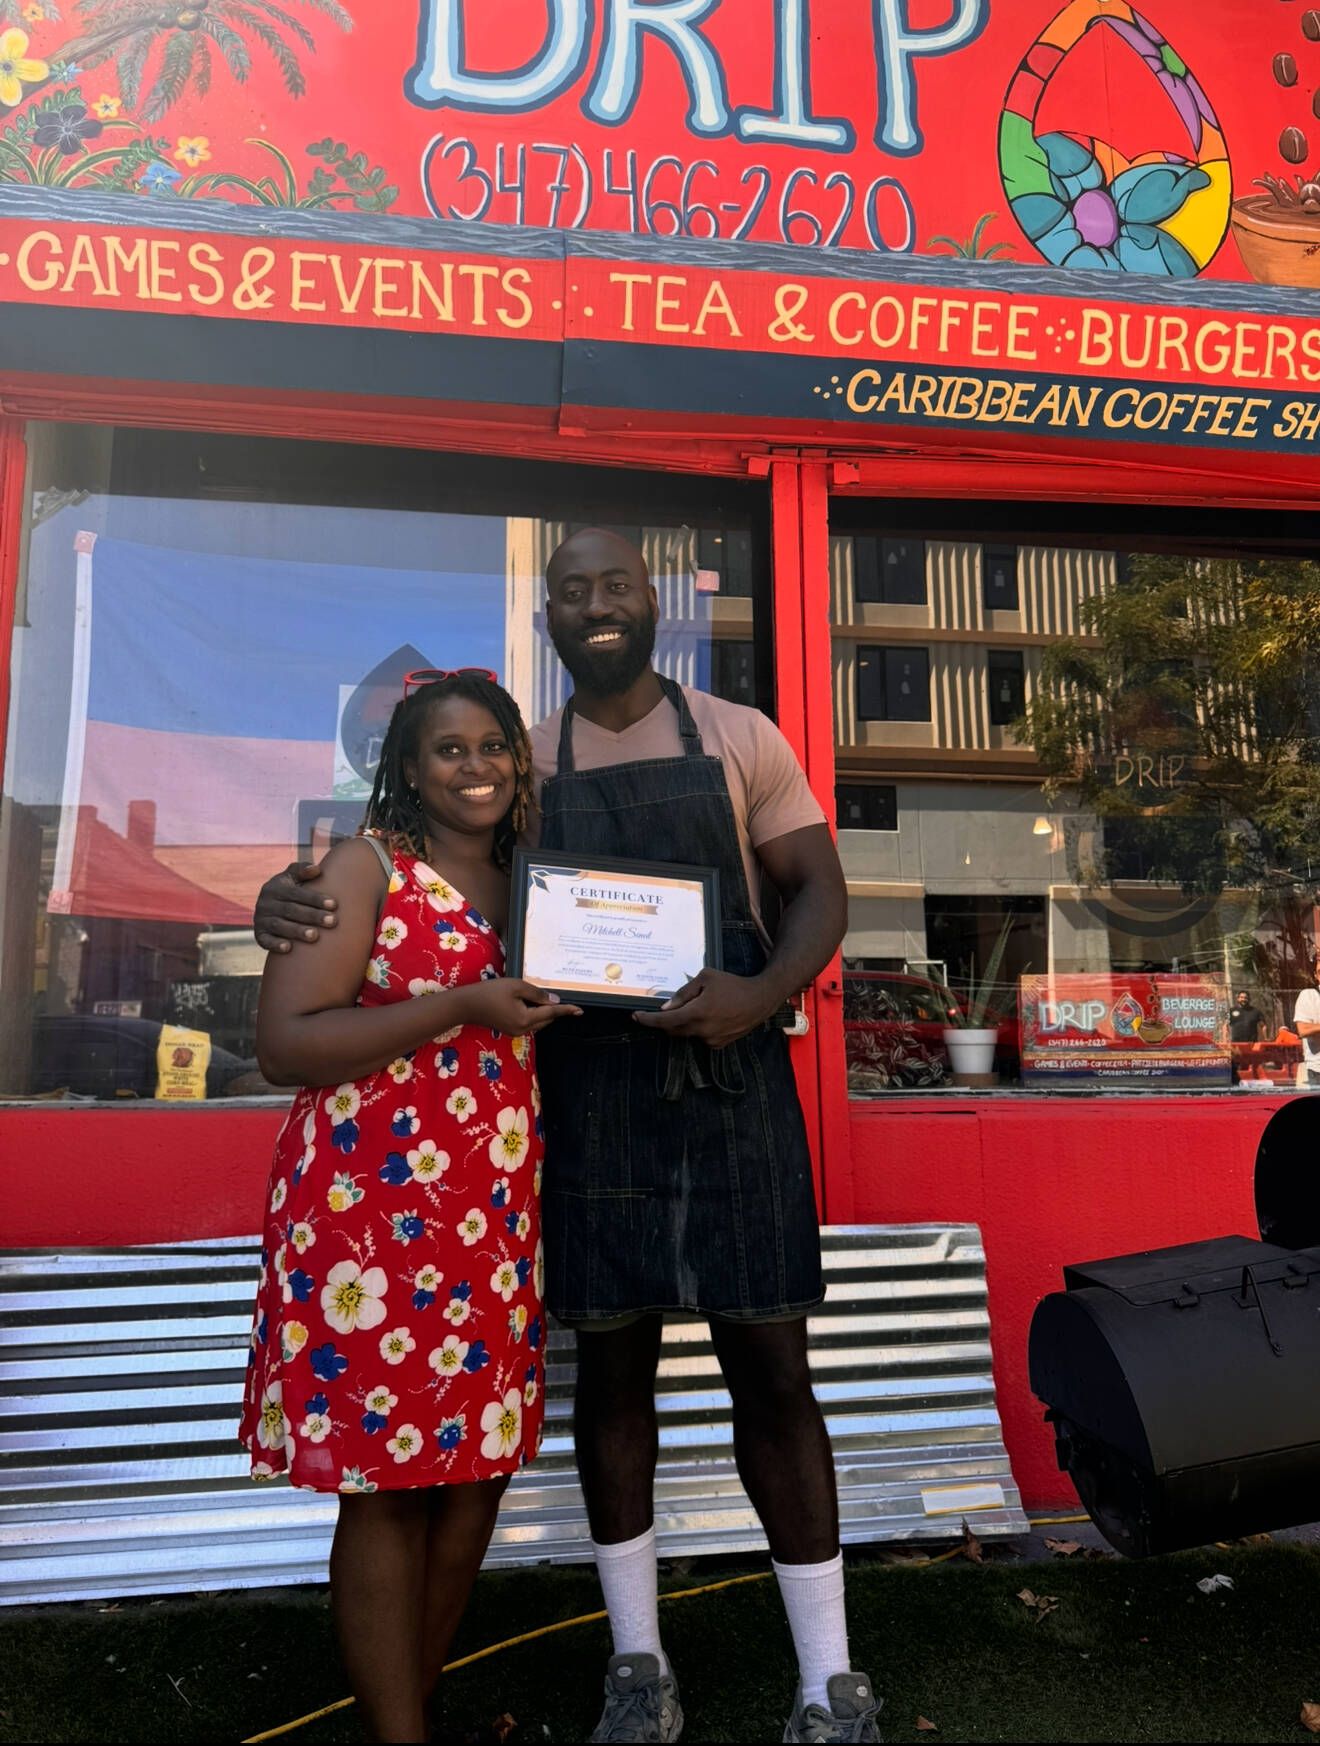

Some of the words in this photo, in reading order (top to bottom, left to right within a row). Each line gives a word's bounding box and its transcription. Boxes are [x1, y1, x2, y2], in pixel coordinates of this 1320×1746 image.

[404, 0, 990, 157] DRIP
[420, 133, 593, 229] (347)
[17, 231, 224, 304] GAMES
[233, 247, 274, 310] &
[290, 251, 532, 329] EVENTS
[610, 273, 741, 337] TEA
[767, 284, 814, 342] &
[828, 292, 1038, 361] COFFEE
[846, 369, 1102, 428] CARIBBEAN
[1103, 388, 1272, 438] COFFEE
[1115, 755, 1184, 788] DRIP
[570, 887, 664, 904] CERTIFICATE
[1039, 999, 1106, 1031] DRIP
[1162, 998, 1216, 1012] BEVERAGE
[1174, 1017, 1216, 1029] LOUNGE
